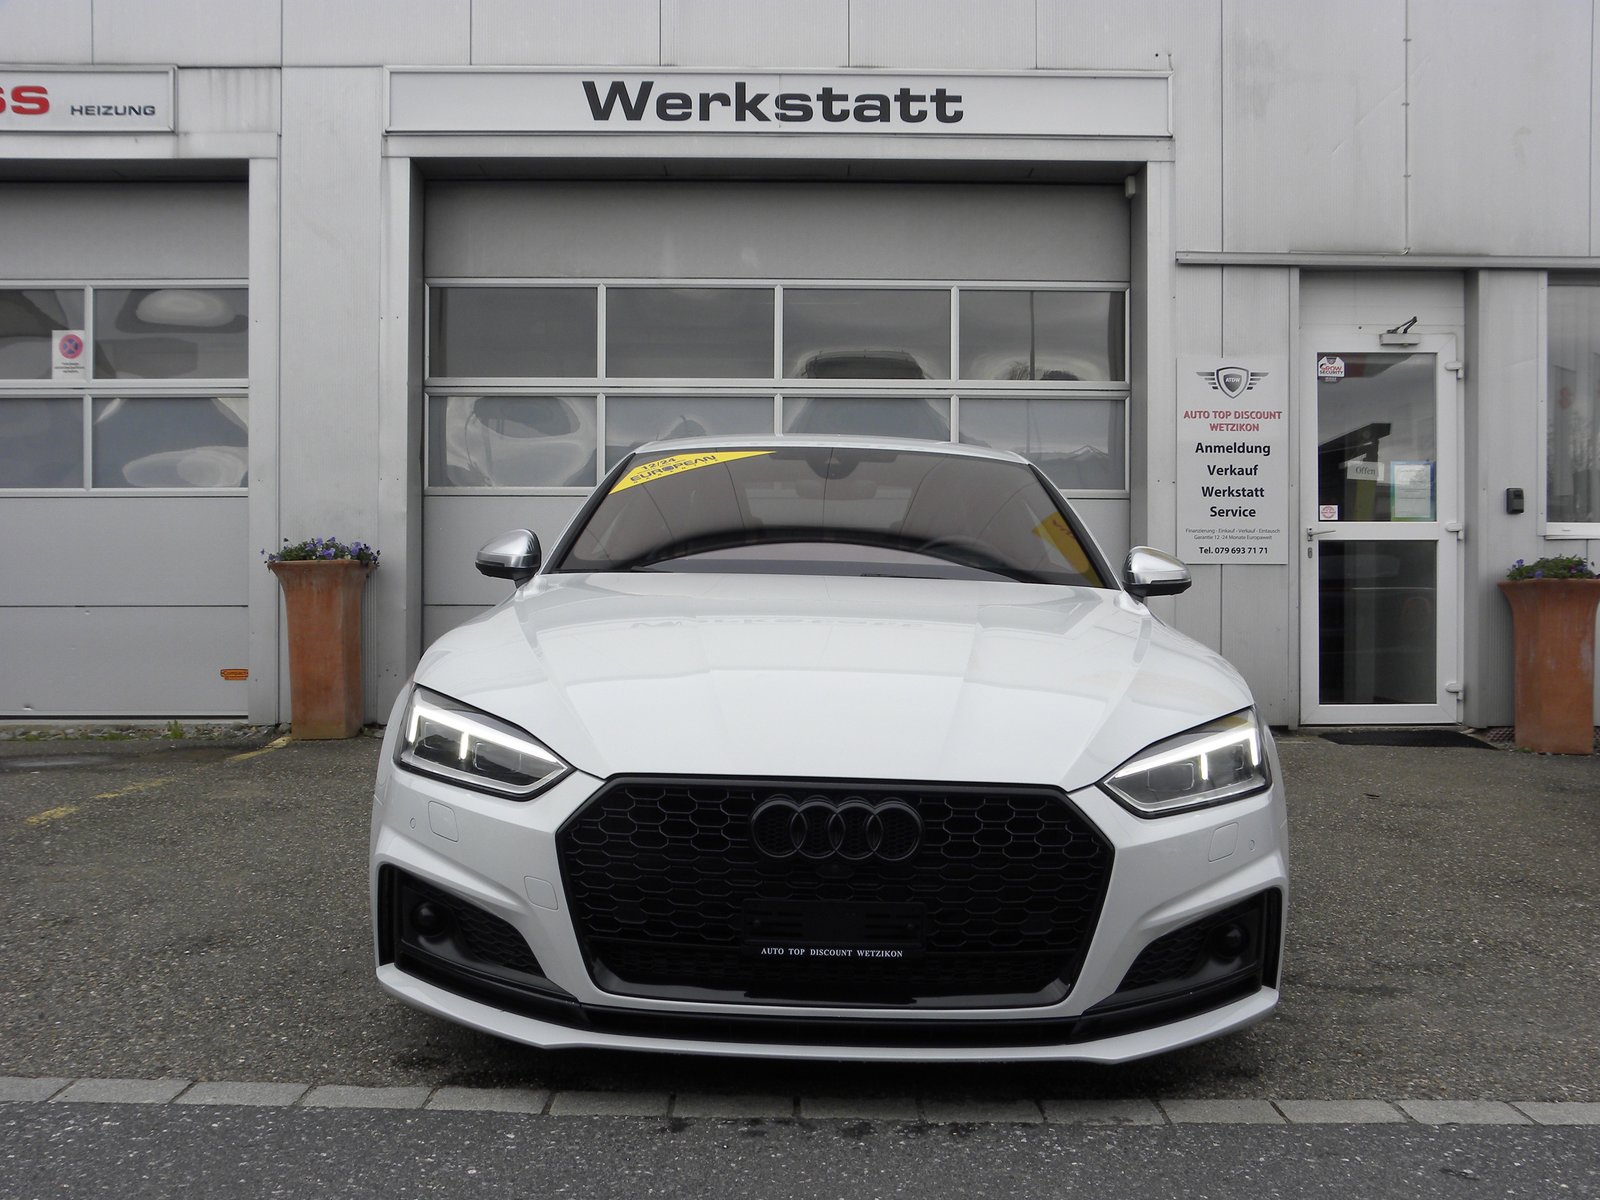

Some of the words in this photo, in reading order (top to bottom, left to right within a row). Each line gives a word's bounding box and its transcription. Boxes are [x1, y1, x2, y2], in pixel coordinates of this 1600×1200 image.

[0, 85, 50, 115] S
[582, 80, 964, 124] Werkstatt
[70, 105, 156, 116] HEIZUNG
[1183, 410, 1210, 420] AUTO
[1212, 410, 1232, 420] TOP
[1234, 410, 1283, 420] DISCOUNT
[1209, 423, 1260, 432] WETZIKON
[1195, 442, 1271, 457] Anmeldung
[630, 455, 717, 482] EUROPEAN
[641, 457, 677, 470] 12/24
[1207, 464, 1259, 476] Verkauf
[1355, 466, 1376, 475] Offen
[1201, 486, 1265, 498] Werkstatt
[1210, 506, 1256, 518] Service
[1198, 546, 1214, 555] Tel.
[1214, 546, 1230, 555] 079
[1231, 546, 1246, 555] 693
[1247, 546, 1257, 555] 71
[1259, 546, 1268, 555] 71
[761, 947, 784, 955] AUTO
[788, 948, 805, 956] TOP
[810, 948, 852, 957] DISCOUNT
[857, 949, 903, 958] WETZIKON
